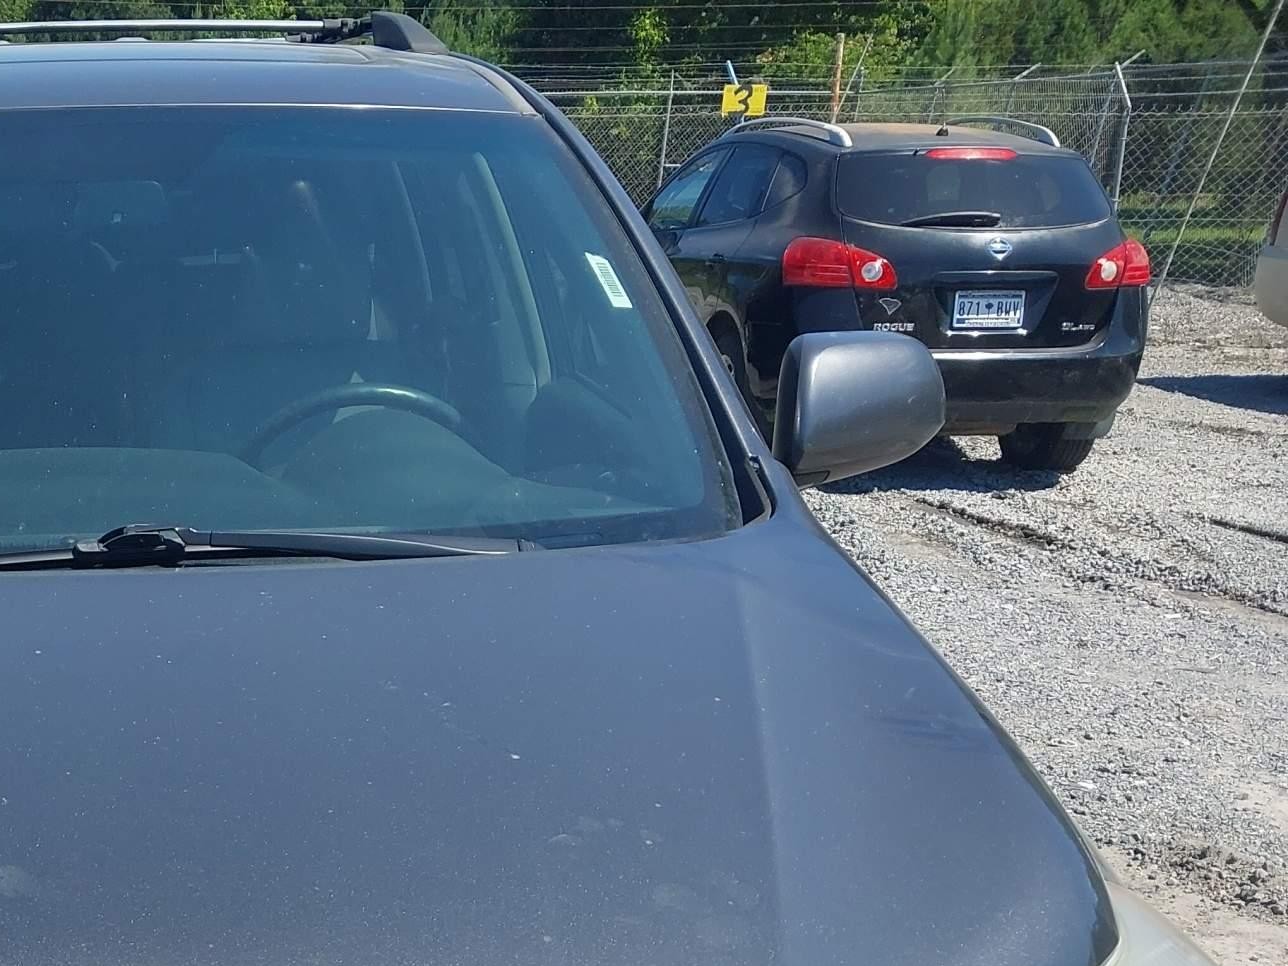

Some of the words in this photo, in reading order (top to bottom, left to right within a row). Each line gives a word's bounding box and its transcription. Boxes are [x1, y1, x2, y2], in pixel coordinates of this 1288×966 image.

[728, 85, 753, 115] 3
[958, 301, 980, 316] 871
[873, 322, 914, 331] ROGUE
